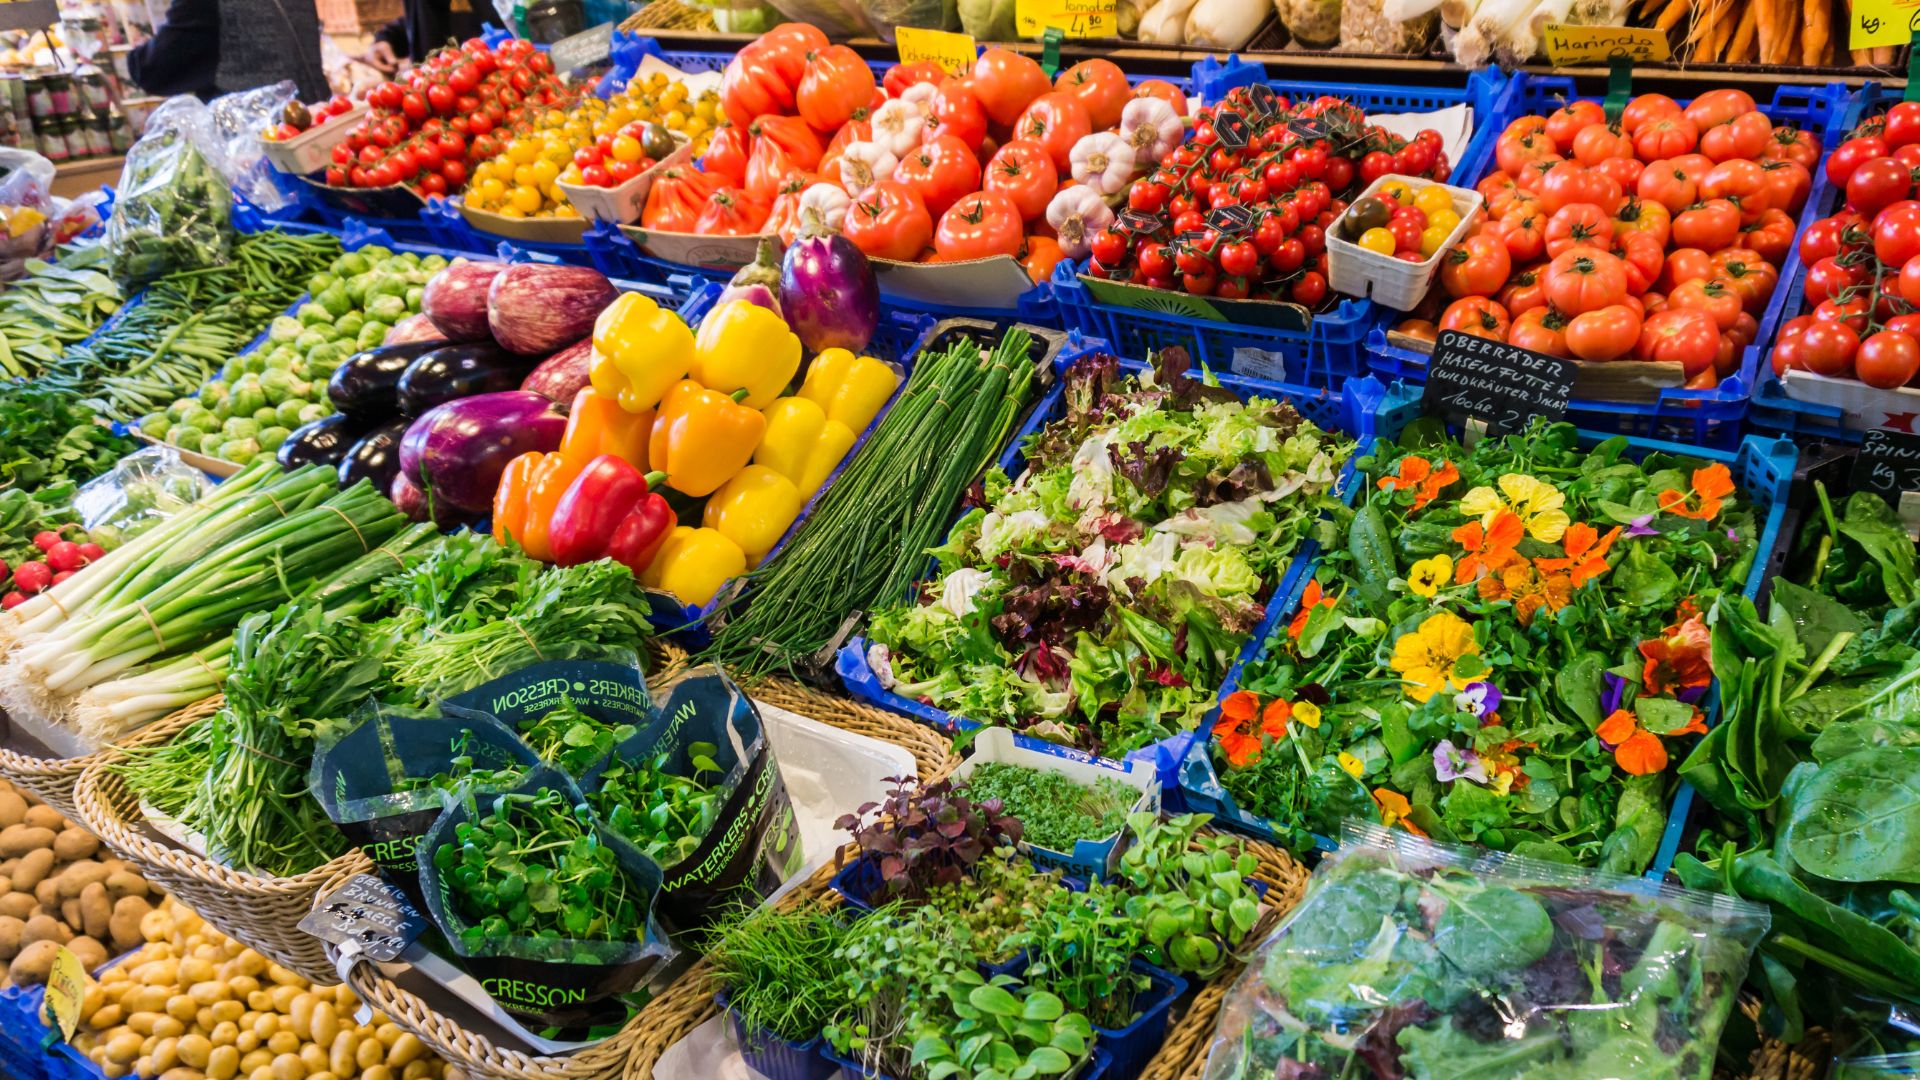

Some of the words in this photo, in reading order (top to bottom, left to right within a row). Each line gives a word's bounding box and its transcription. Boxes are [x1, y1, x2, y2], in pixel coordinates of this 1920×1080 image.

[1443, 332, 1563, 378] OBERRÄDER
[661, 805, 750, 893] WATERKERS
[703, 831, 746, 885] WATERCRESS
[481, 978, 586, 1007] CRESSON
